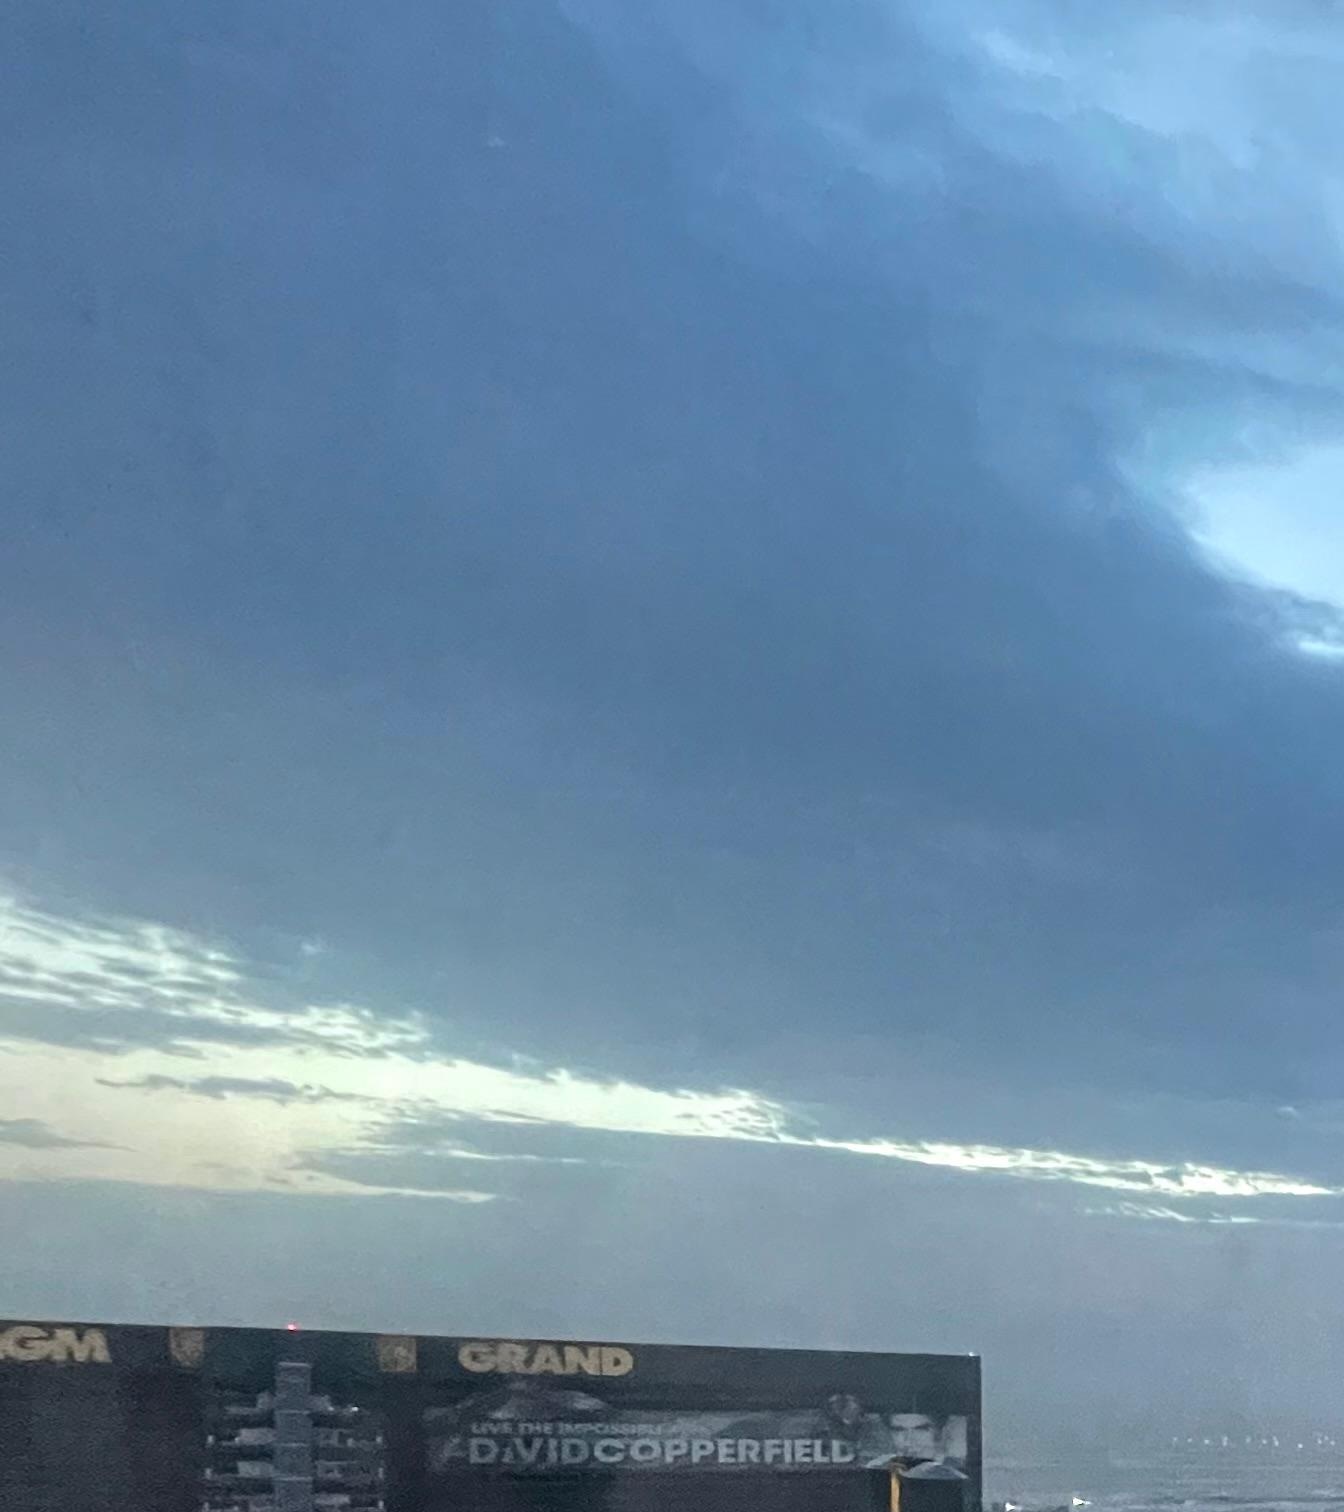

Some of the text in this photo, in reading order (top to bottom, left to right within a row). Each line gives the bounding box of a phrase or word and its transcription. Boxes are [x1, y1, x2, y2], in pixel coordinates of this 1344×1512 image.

[0, 1326, 633, 1376] GM GRAND
[519, 1422, 553, 1435] THE
